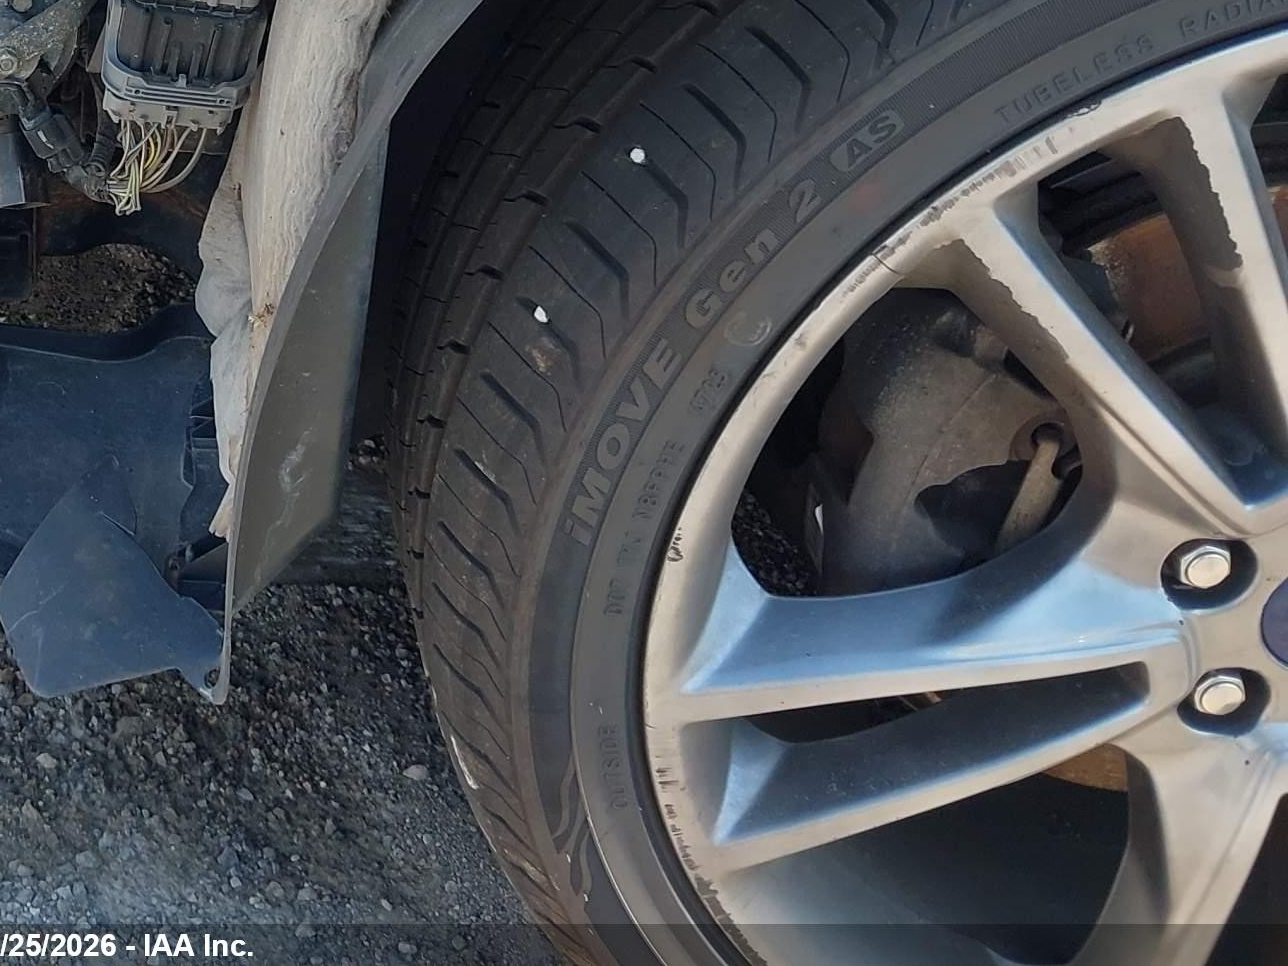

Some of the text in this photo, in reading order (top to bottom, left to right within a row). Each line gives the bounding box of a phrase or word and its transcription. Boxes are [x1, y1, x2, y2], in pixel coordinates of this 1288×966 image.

[995, 35, 1155, 121] TUBELESS
[564, 114, 898, 547] iMOVE Gen 2 AS
